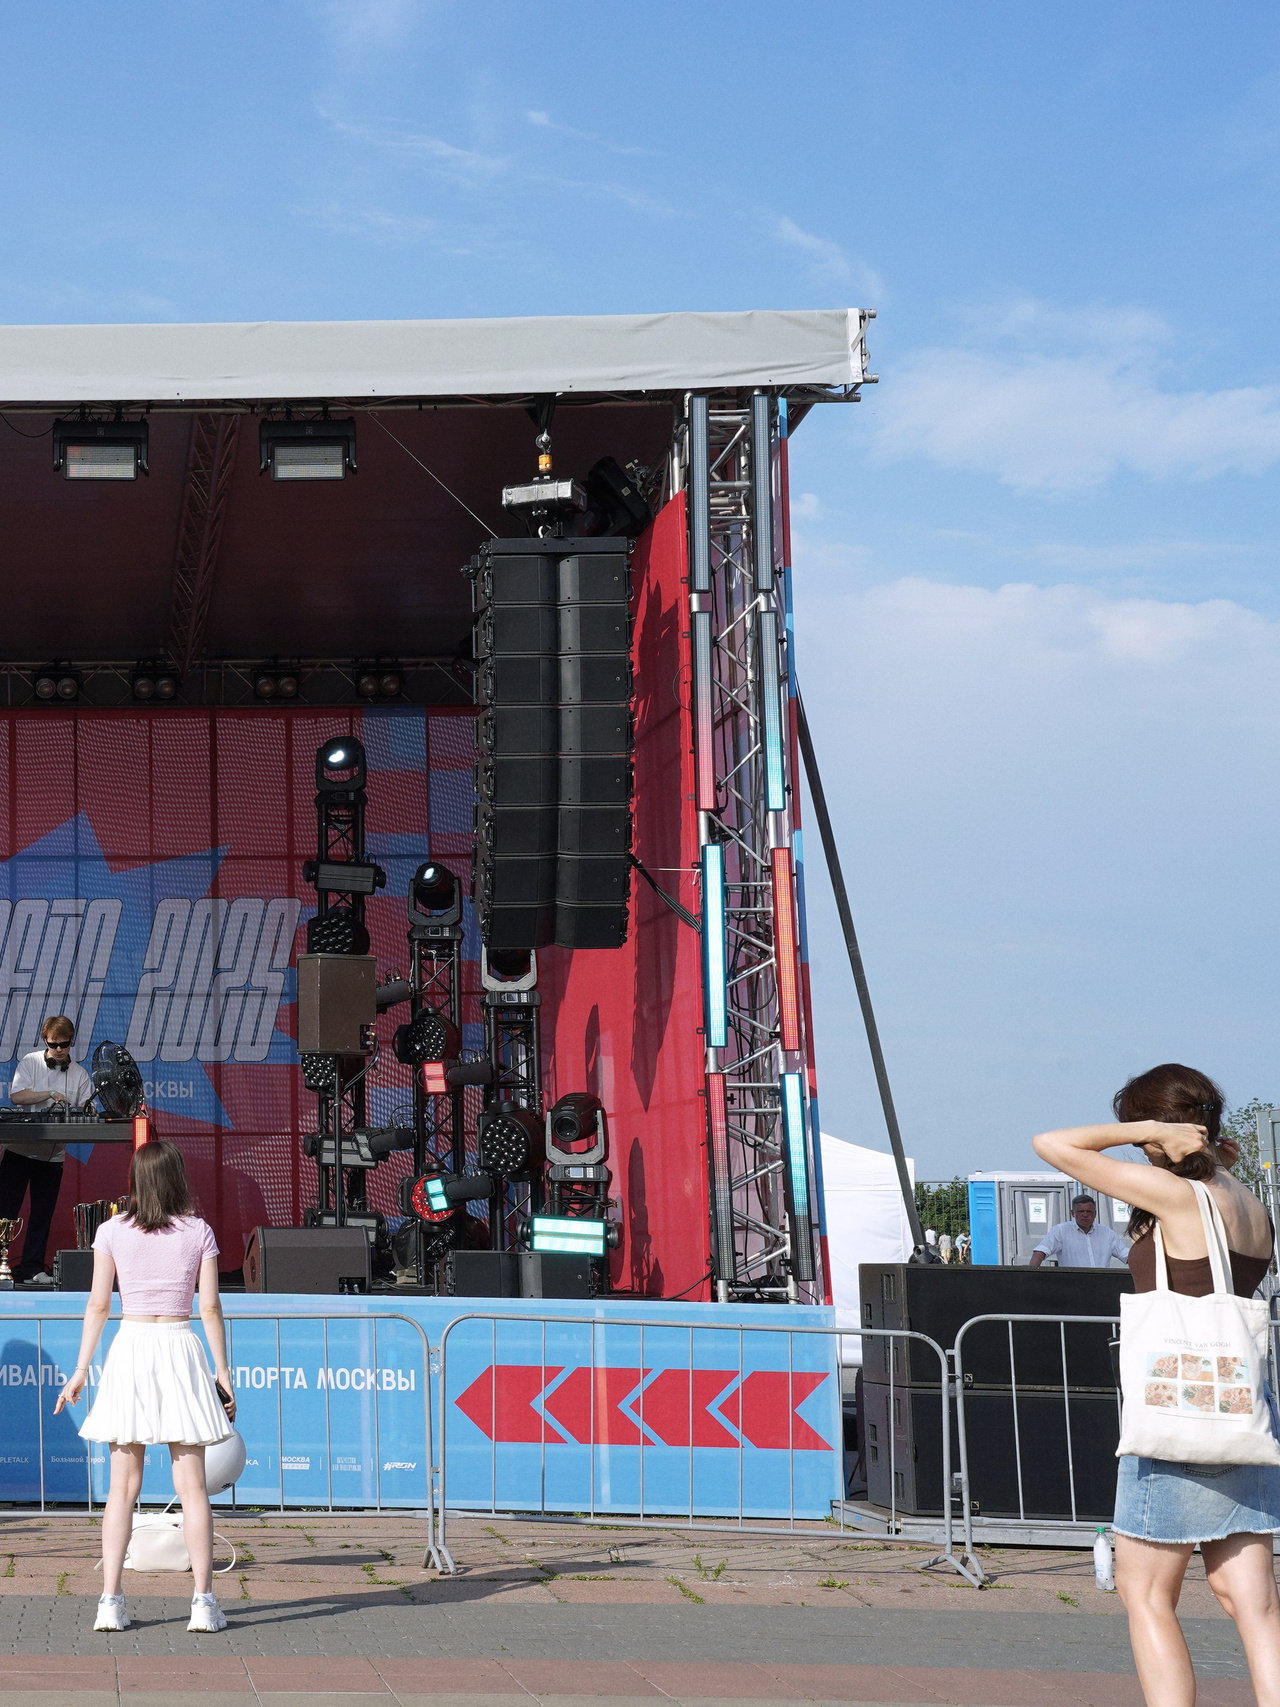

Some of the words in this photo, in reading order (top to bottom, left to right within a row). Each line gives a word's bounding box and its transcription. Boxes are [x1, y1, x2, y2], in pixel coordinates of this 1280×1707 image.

[123, 897, 302, 1063] 2025
[142, 1080, 194, 1099] СКВЫ
[1163, 1338, 1192, 1347] VINCENT
[316, 1367, 415, 1392] МОСКВЫ
[51, 1455, 84, 1463] Большой
